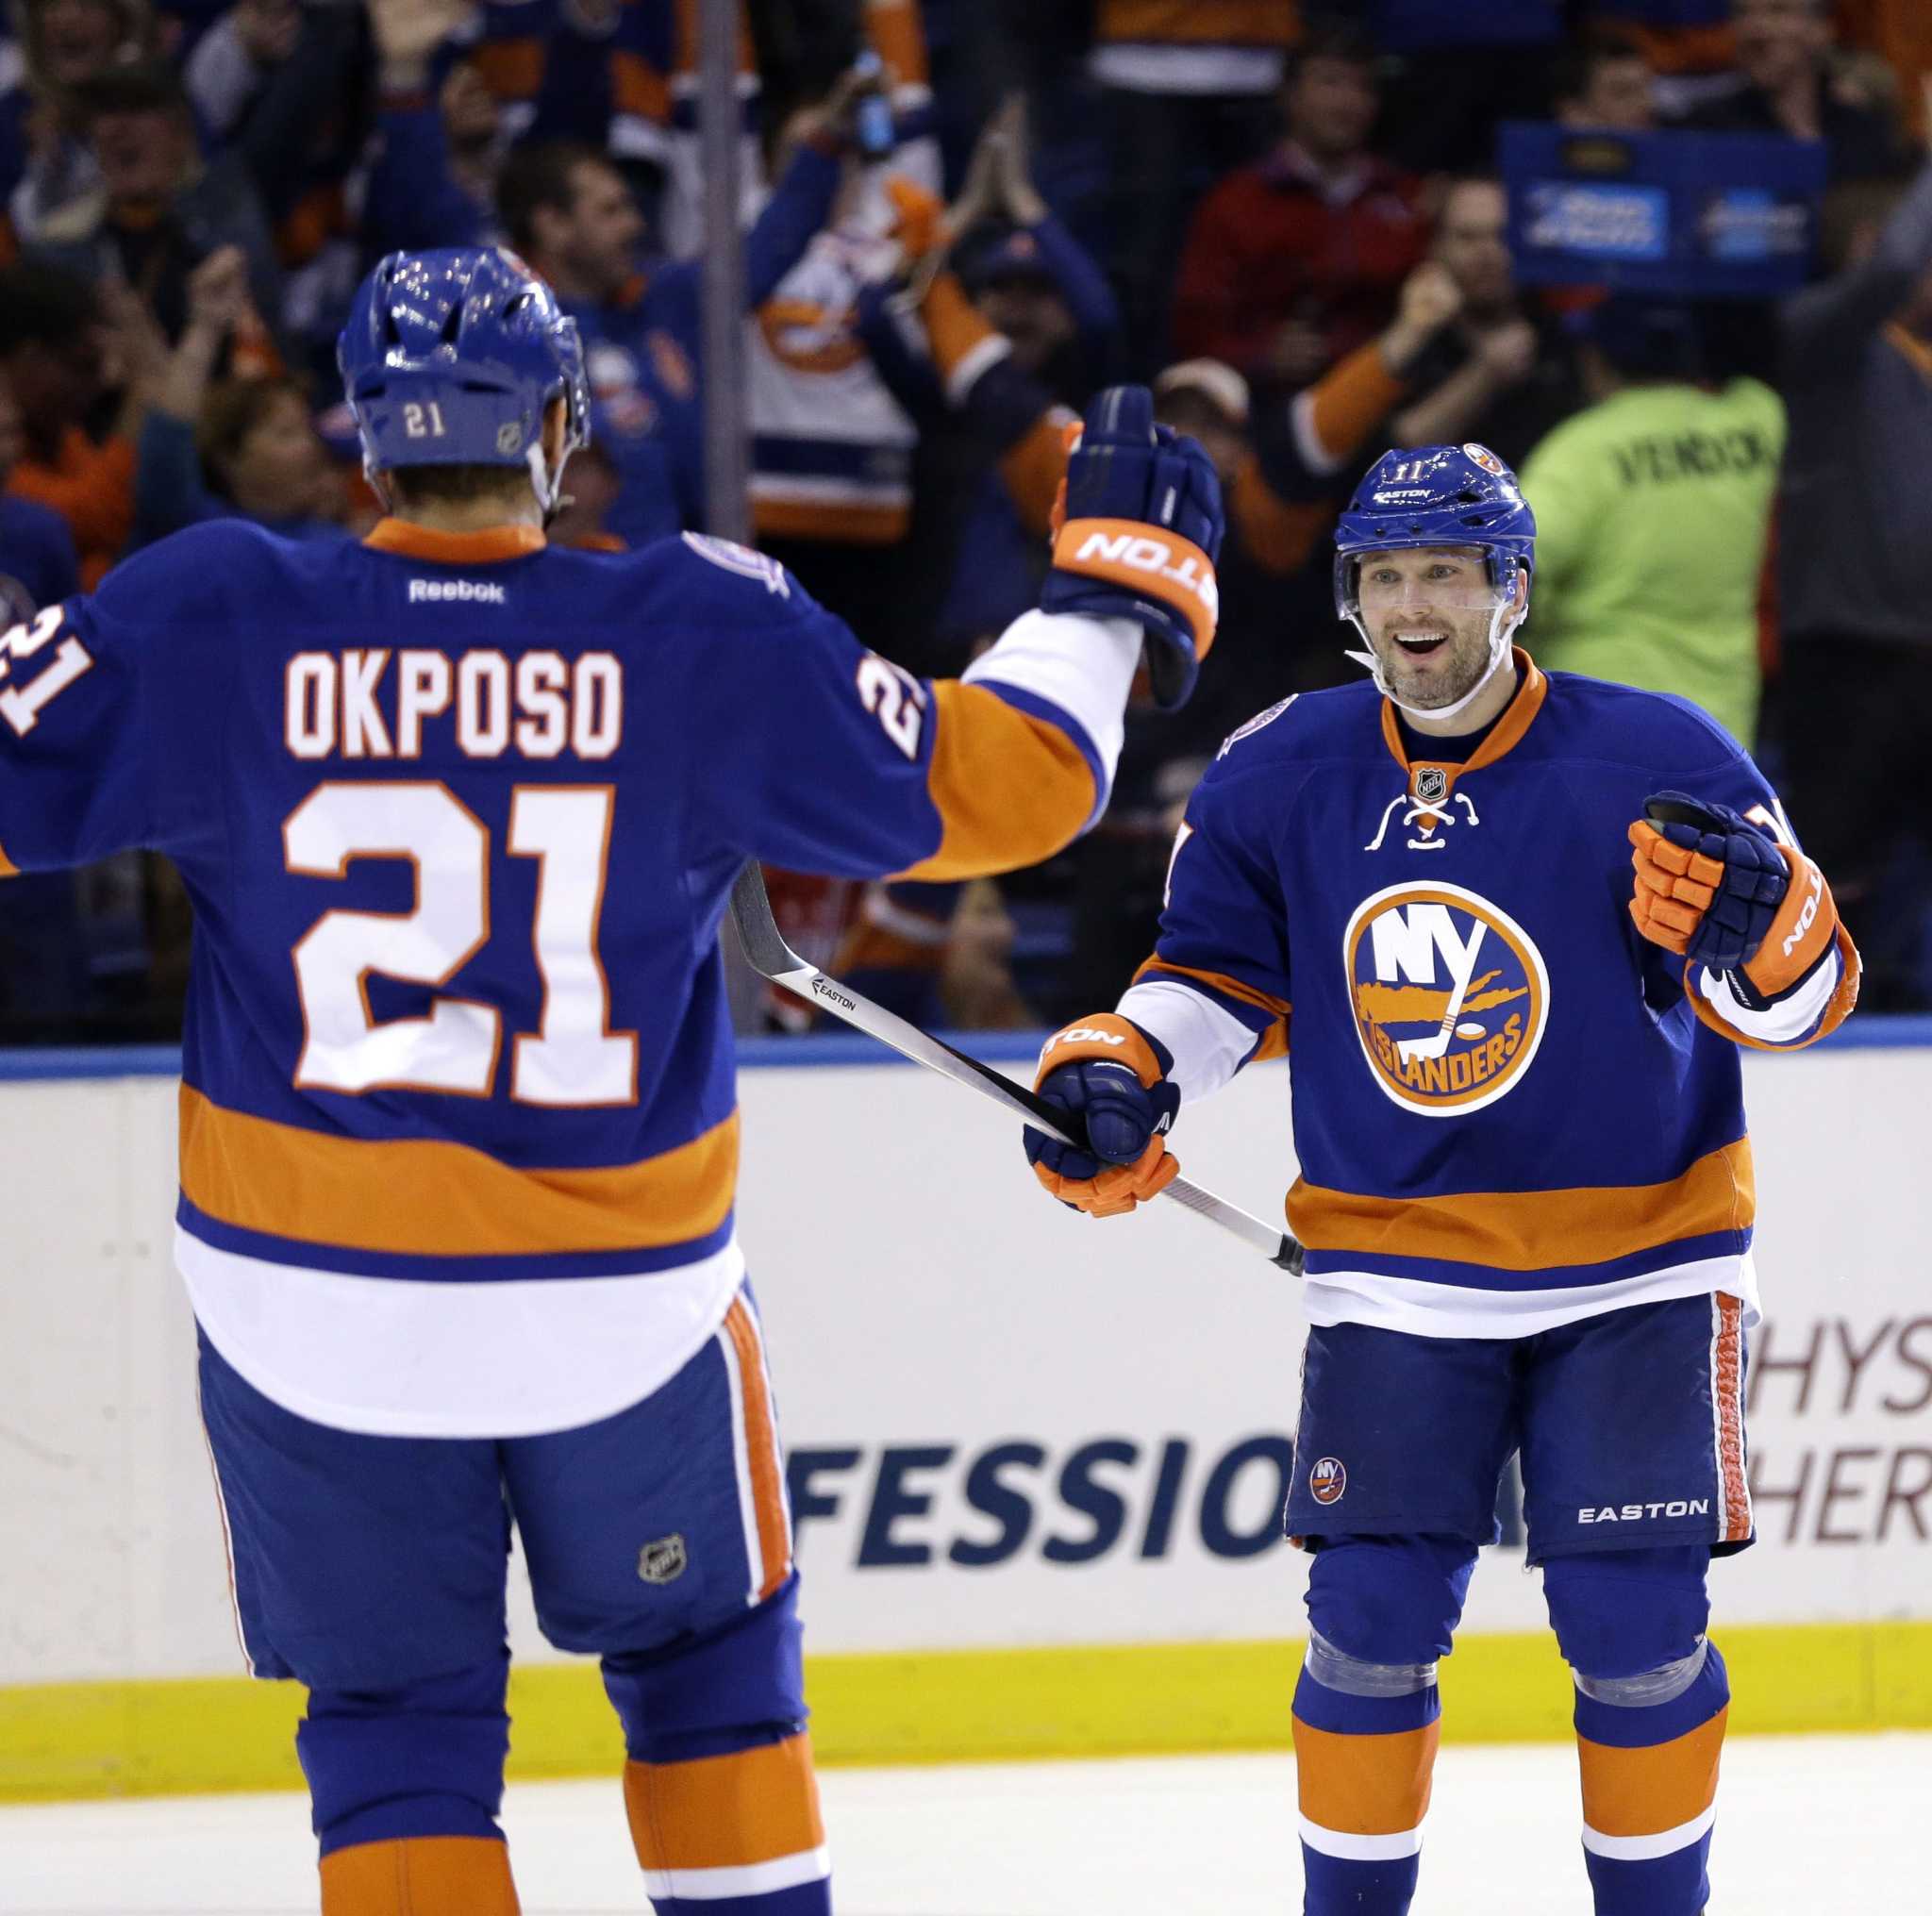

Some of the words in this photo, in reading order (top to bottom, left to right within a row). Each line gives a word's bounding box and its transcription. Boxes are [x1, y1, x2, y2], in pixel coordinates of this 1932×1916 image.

[404, 402, 446, 438] 21
[1373, 489, 1434, 503] EASTON
[408, 578, 507, 604] Reebok
[285, 649, 624, 759] OKPOSO
[282, 780, 640, 1109] 21
[1371, 904, 1488, 991] NY
[819, 985, 857, 1011] EASTON
[1037, 1028, 1124, 1077] TON
[1577, 1498, 1709, 1524] EASTON
